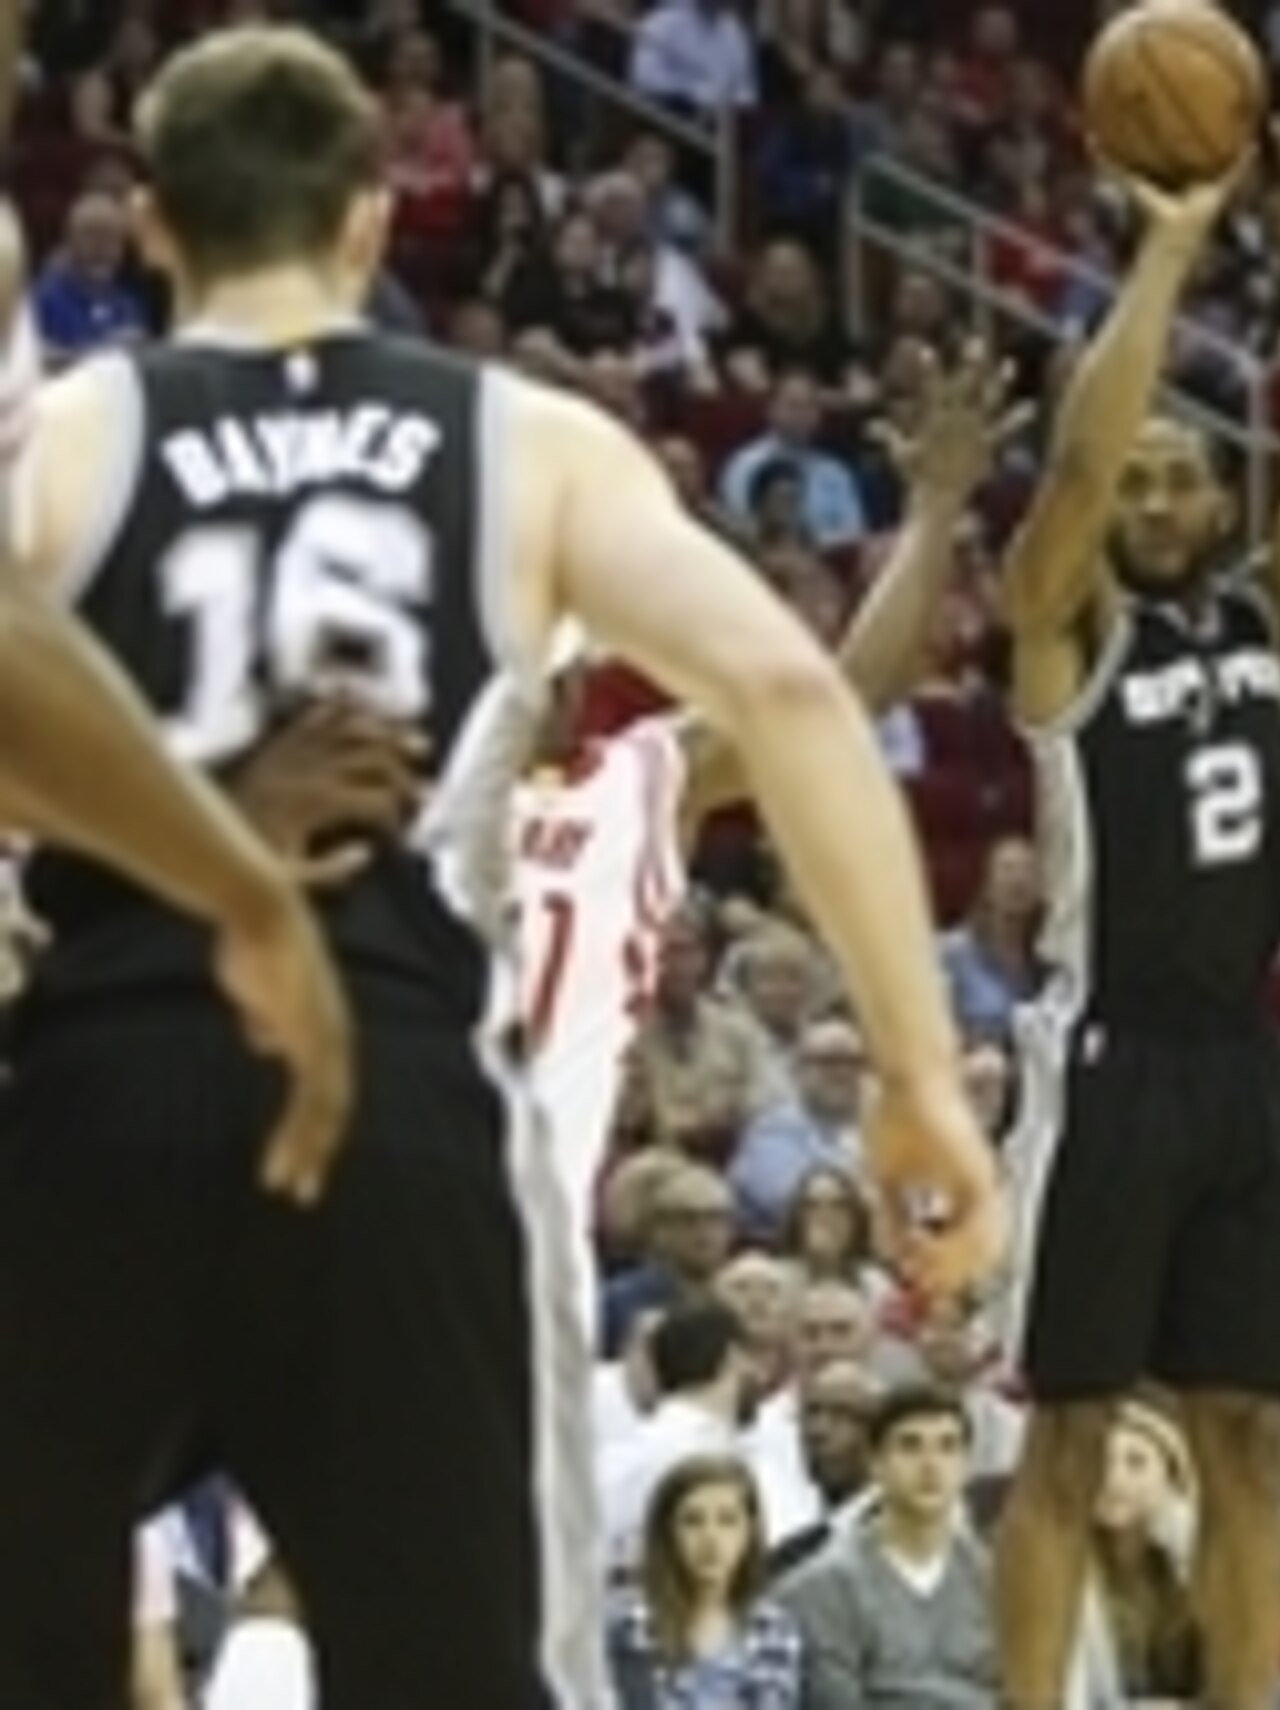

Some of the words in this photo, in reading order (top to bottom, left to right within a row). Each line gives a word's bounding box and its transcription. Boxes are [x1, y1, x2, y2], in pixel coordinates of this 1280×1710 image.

[162, 403, 441, 507] BAYNES
[157, 499, 433, 767] 16
[1186, 744, 1263, 864] 2
